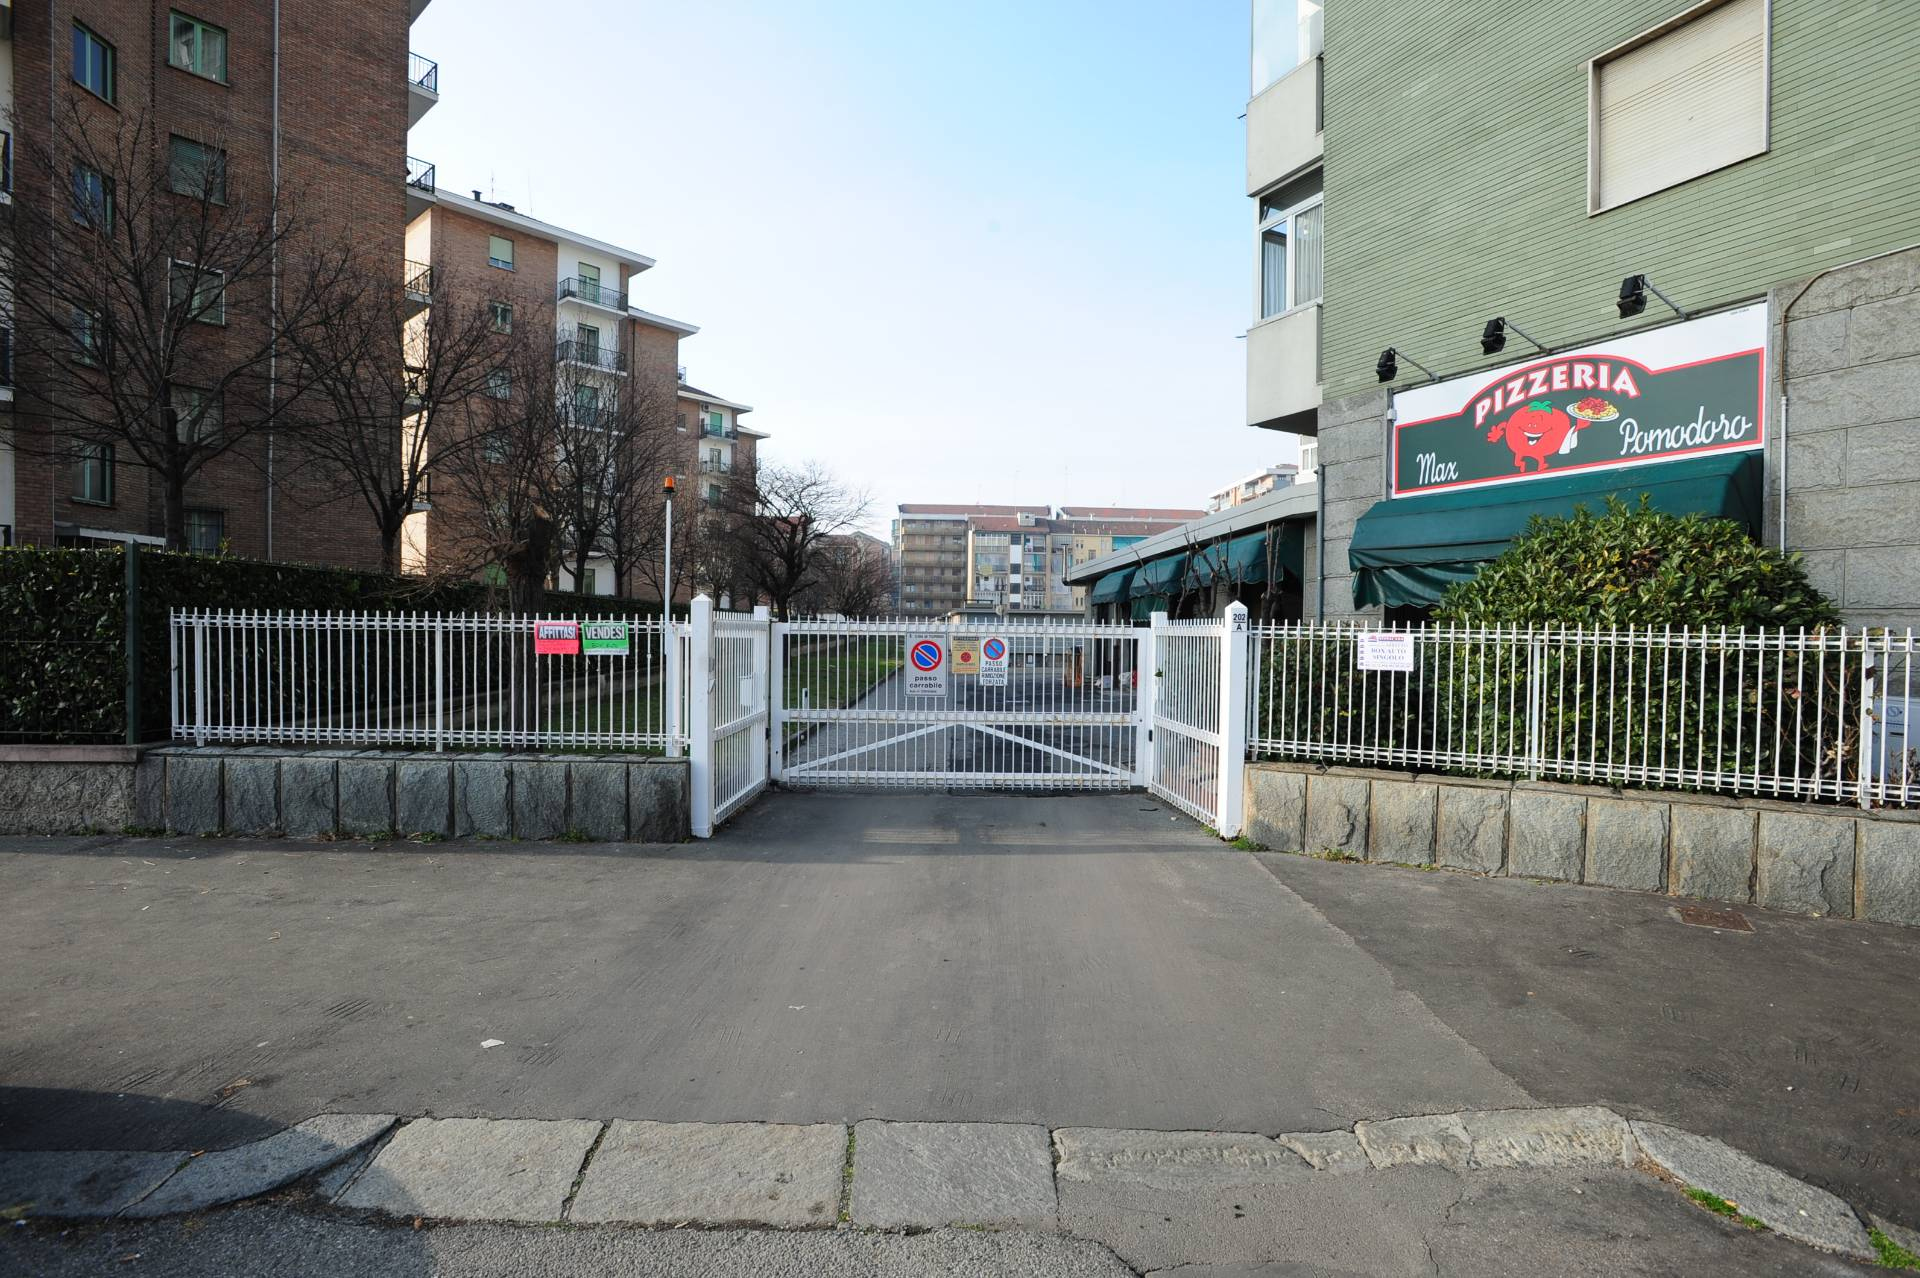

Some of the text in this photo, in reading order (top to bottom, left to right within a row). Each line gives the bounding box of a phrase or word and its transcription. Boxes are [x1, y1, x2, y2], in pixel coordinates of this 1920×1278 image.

[1475, 362, 1640, 428] PIZZERIA
[1416, 406, 1753, 485] Max Pomodoro
[539, 626, 576, 640] AFFITTASI
[585, 626, 625, 640] VENDESI
